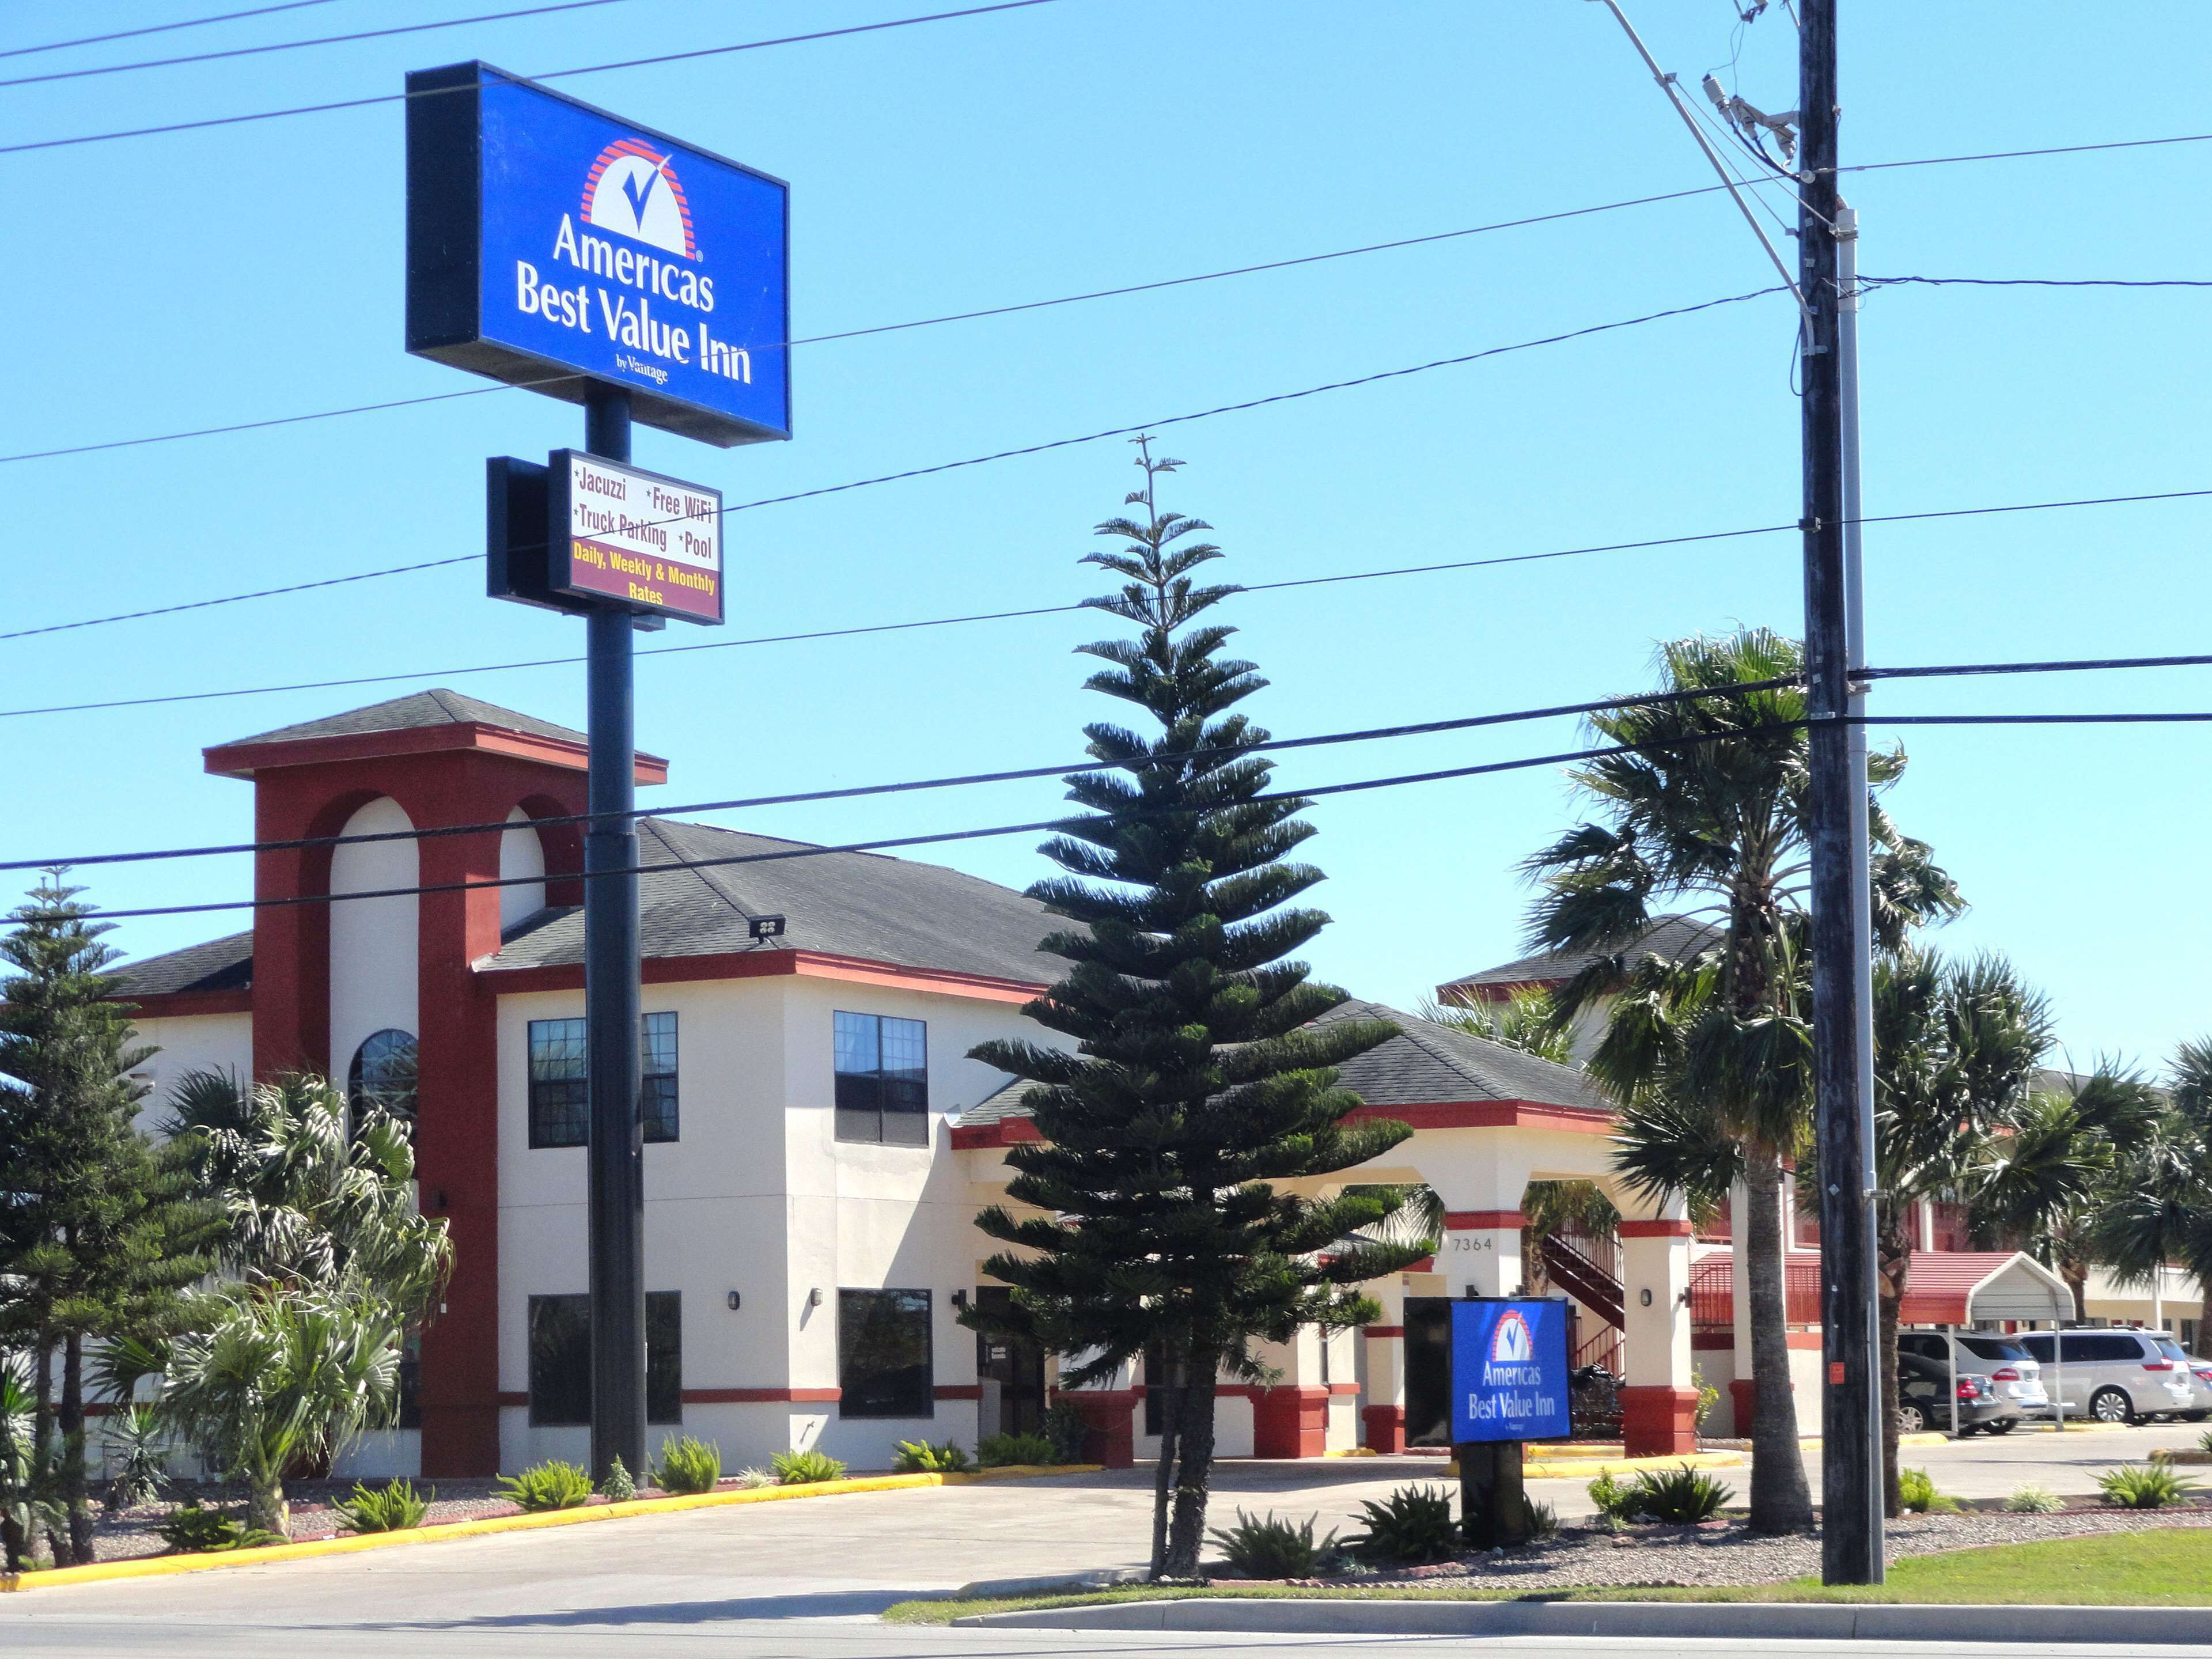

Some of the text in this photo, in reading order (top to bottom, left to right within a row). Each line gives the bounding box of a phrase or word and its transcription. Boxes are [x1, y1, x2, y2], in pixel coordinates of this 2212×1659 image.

[553, 212, 714, 313] Americas
[517, 260, 751, 385] Best Value Inn
[615, 354, 668, 385] by Vantage
[579, 467, 711, 524] Jacuzzi Free WiFi
[579, 503, 711, 559] Truck Parking Pool
[574, 541, 715, 596] Daily, Weekly & Monthly
[628, 582, 663, 605] Rates
[1454, 1238, 1492, 1251] 7364
[1482, 1361, 1541, 1386] Americas
[1469, 1390, 1555, 1419] Best Value Inn
